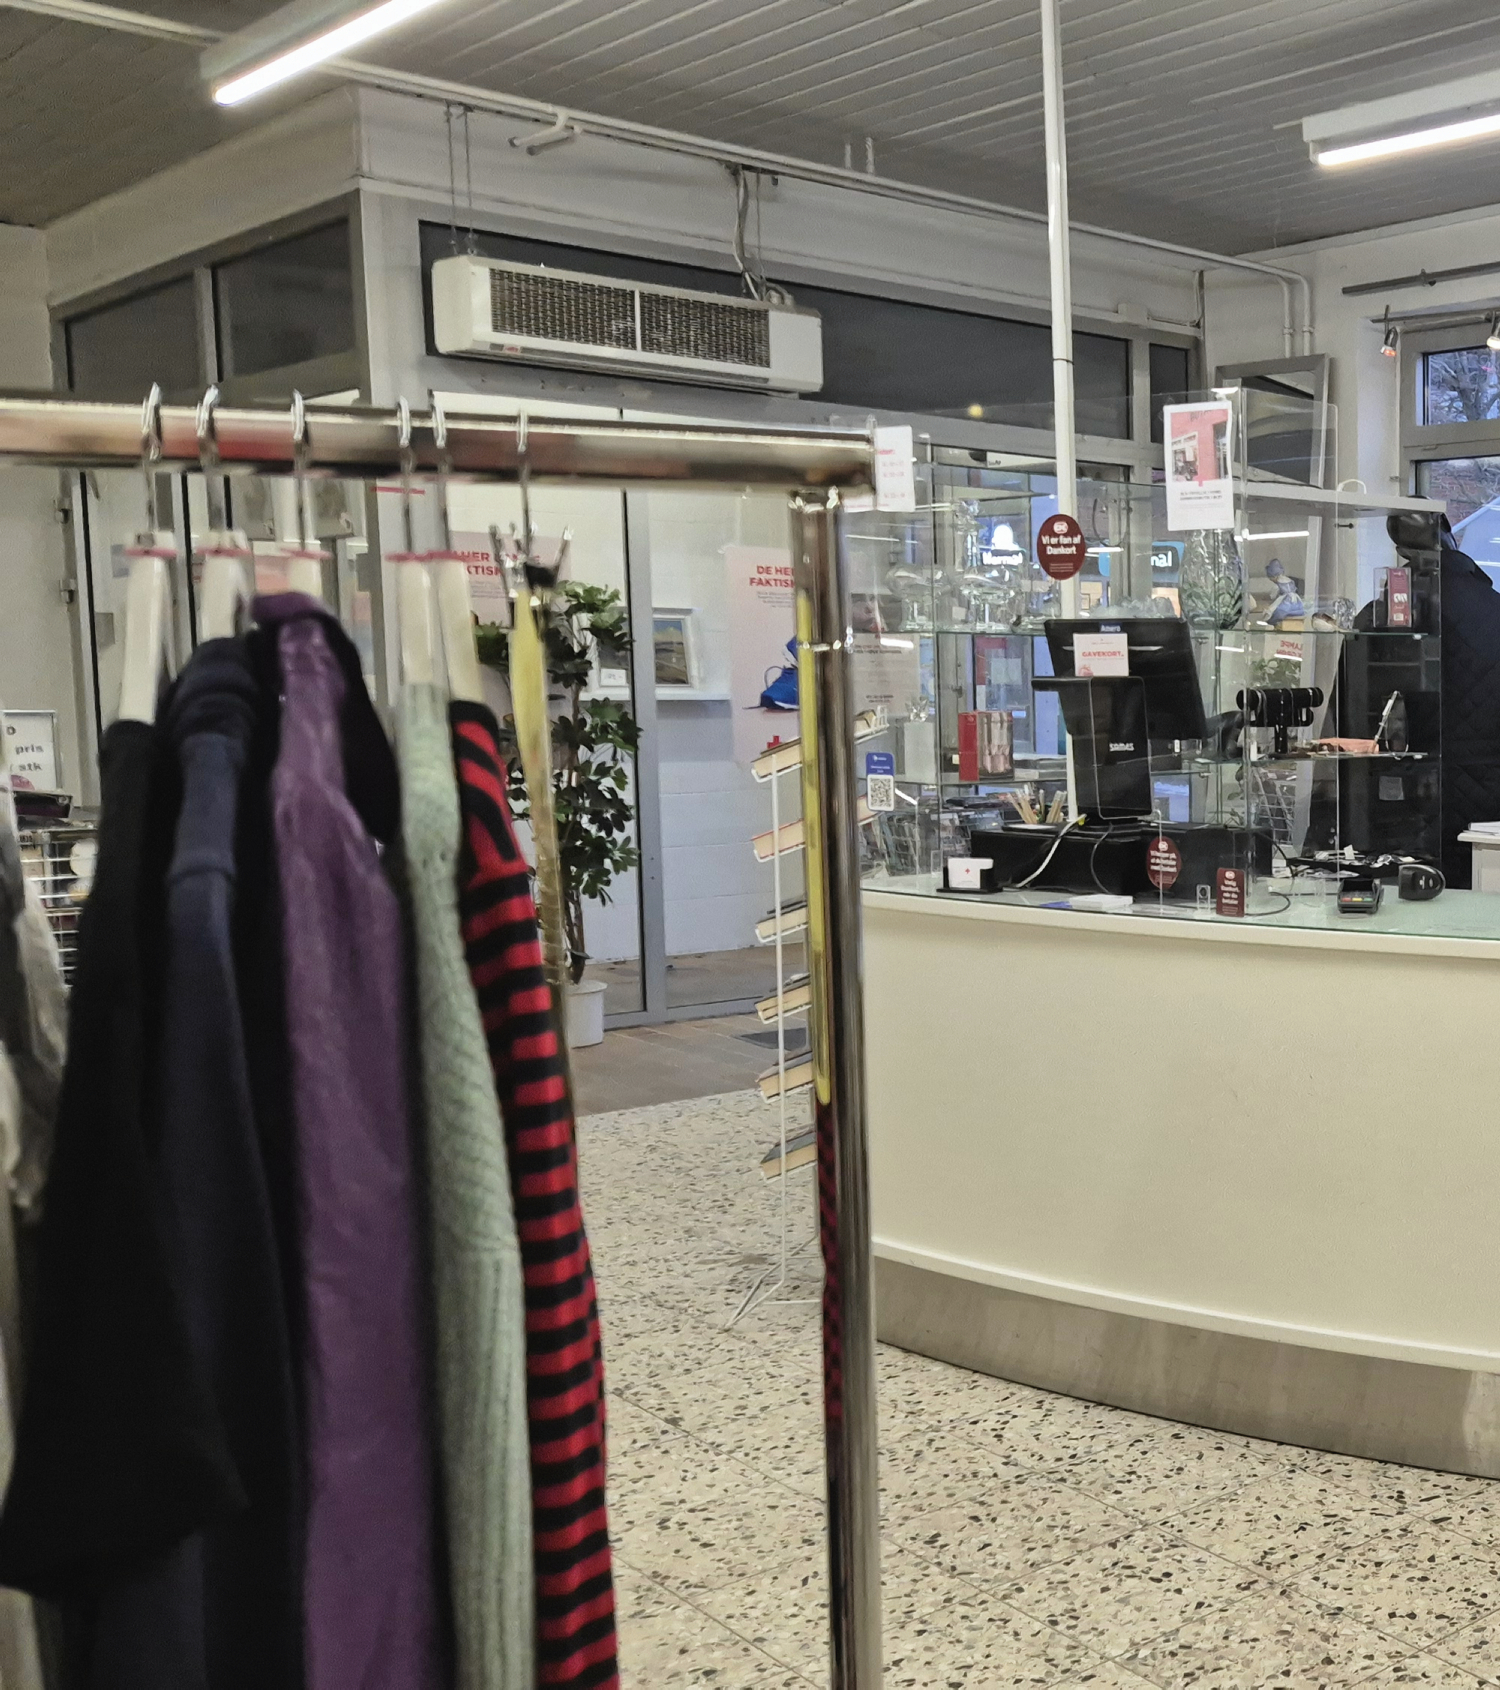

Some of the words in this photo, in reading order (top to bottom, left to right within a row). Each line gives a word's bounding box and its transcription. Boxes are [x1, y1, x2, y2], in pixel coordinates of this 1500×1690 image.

[1041, 535, 1049, 544] Vi
[1046, 545, 1077, 555] Dankort
[757, 566, 772, 575] DE
